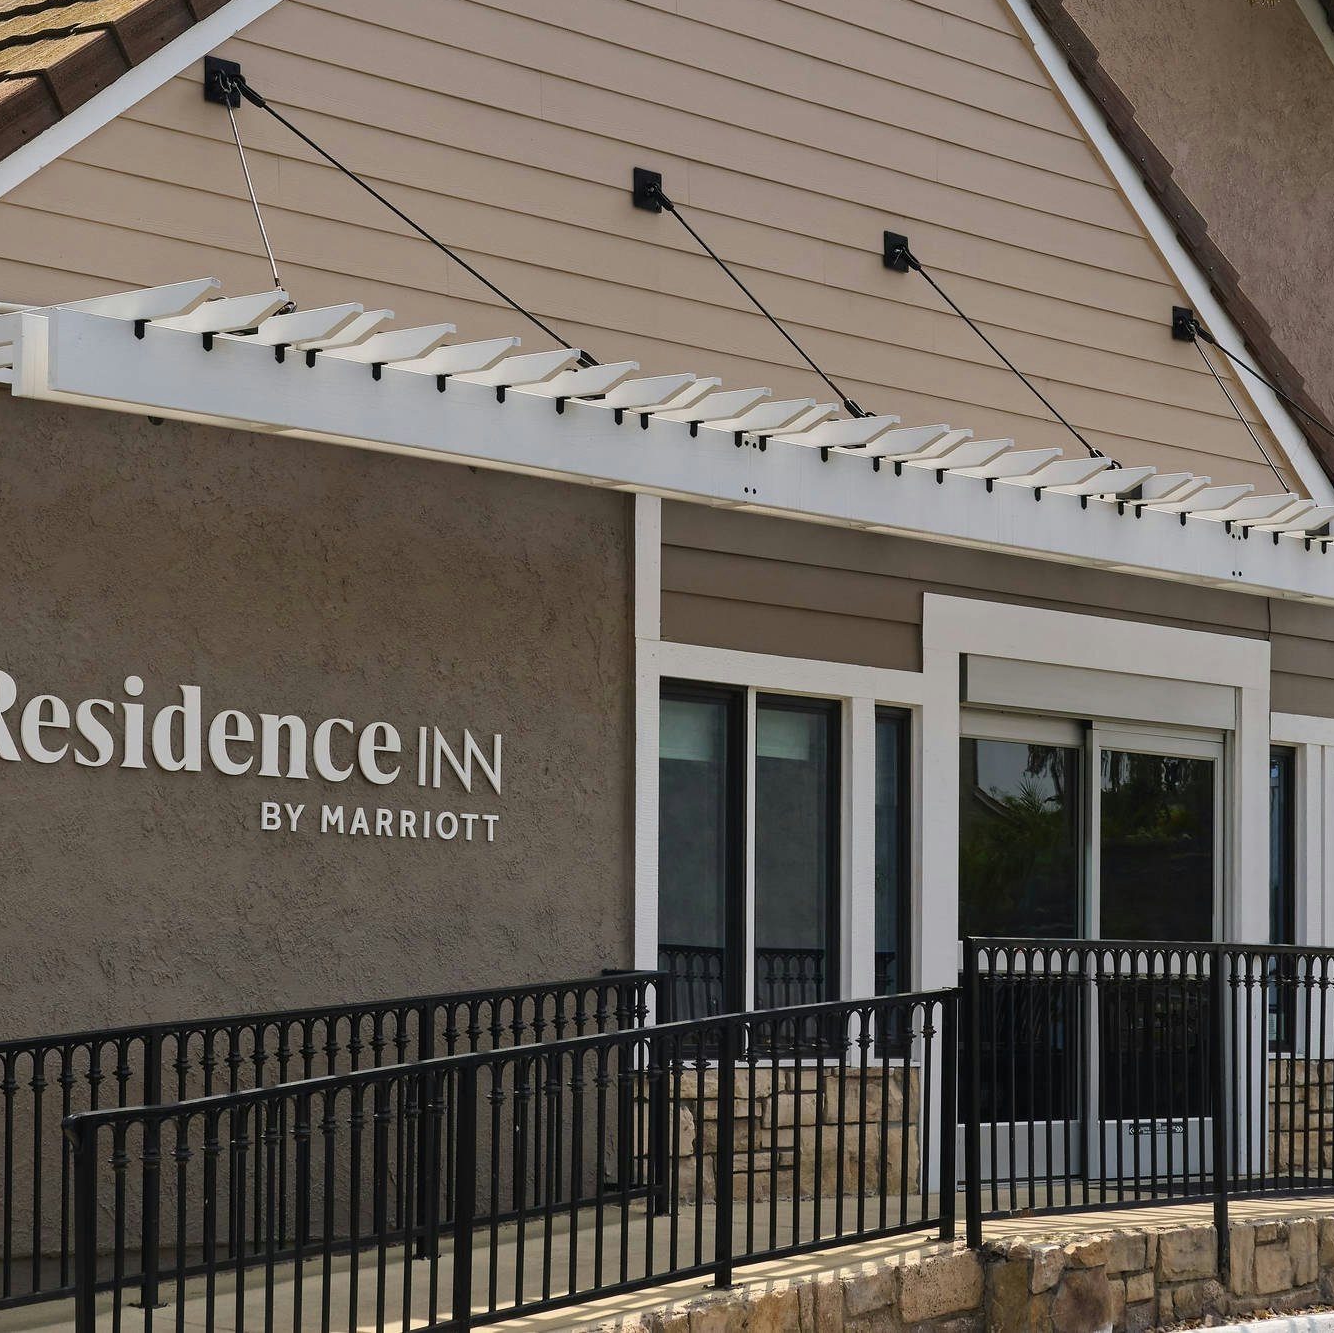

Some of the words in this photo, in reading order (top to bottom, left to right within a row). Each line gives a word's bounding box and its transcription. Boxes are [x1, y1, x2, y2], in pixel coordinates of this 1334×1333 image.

[417, 725, 503, 795] INN
[260, 801, 307, 832] BY
[320, 804, 501, 842] MARRIOTT
